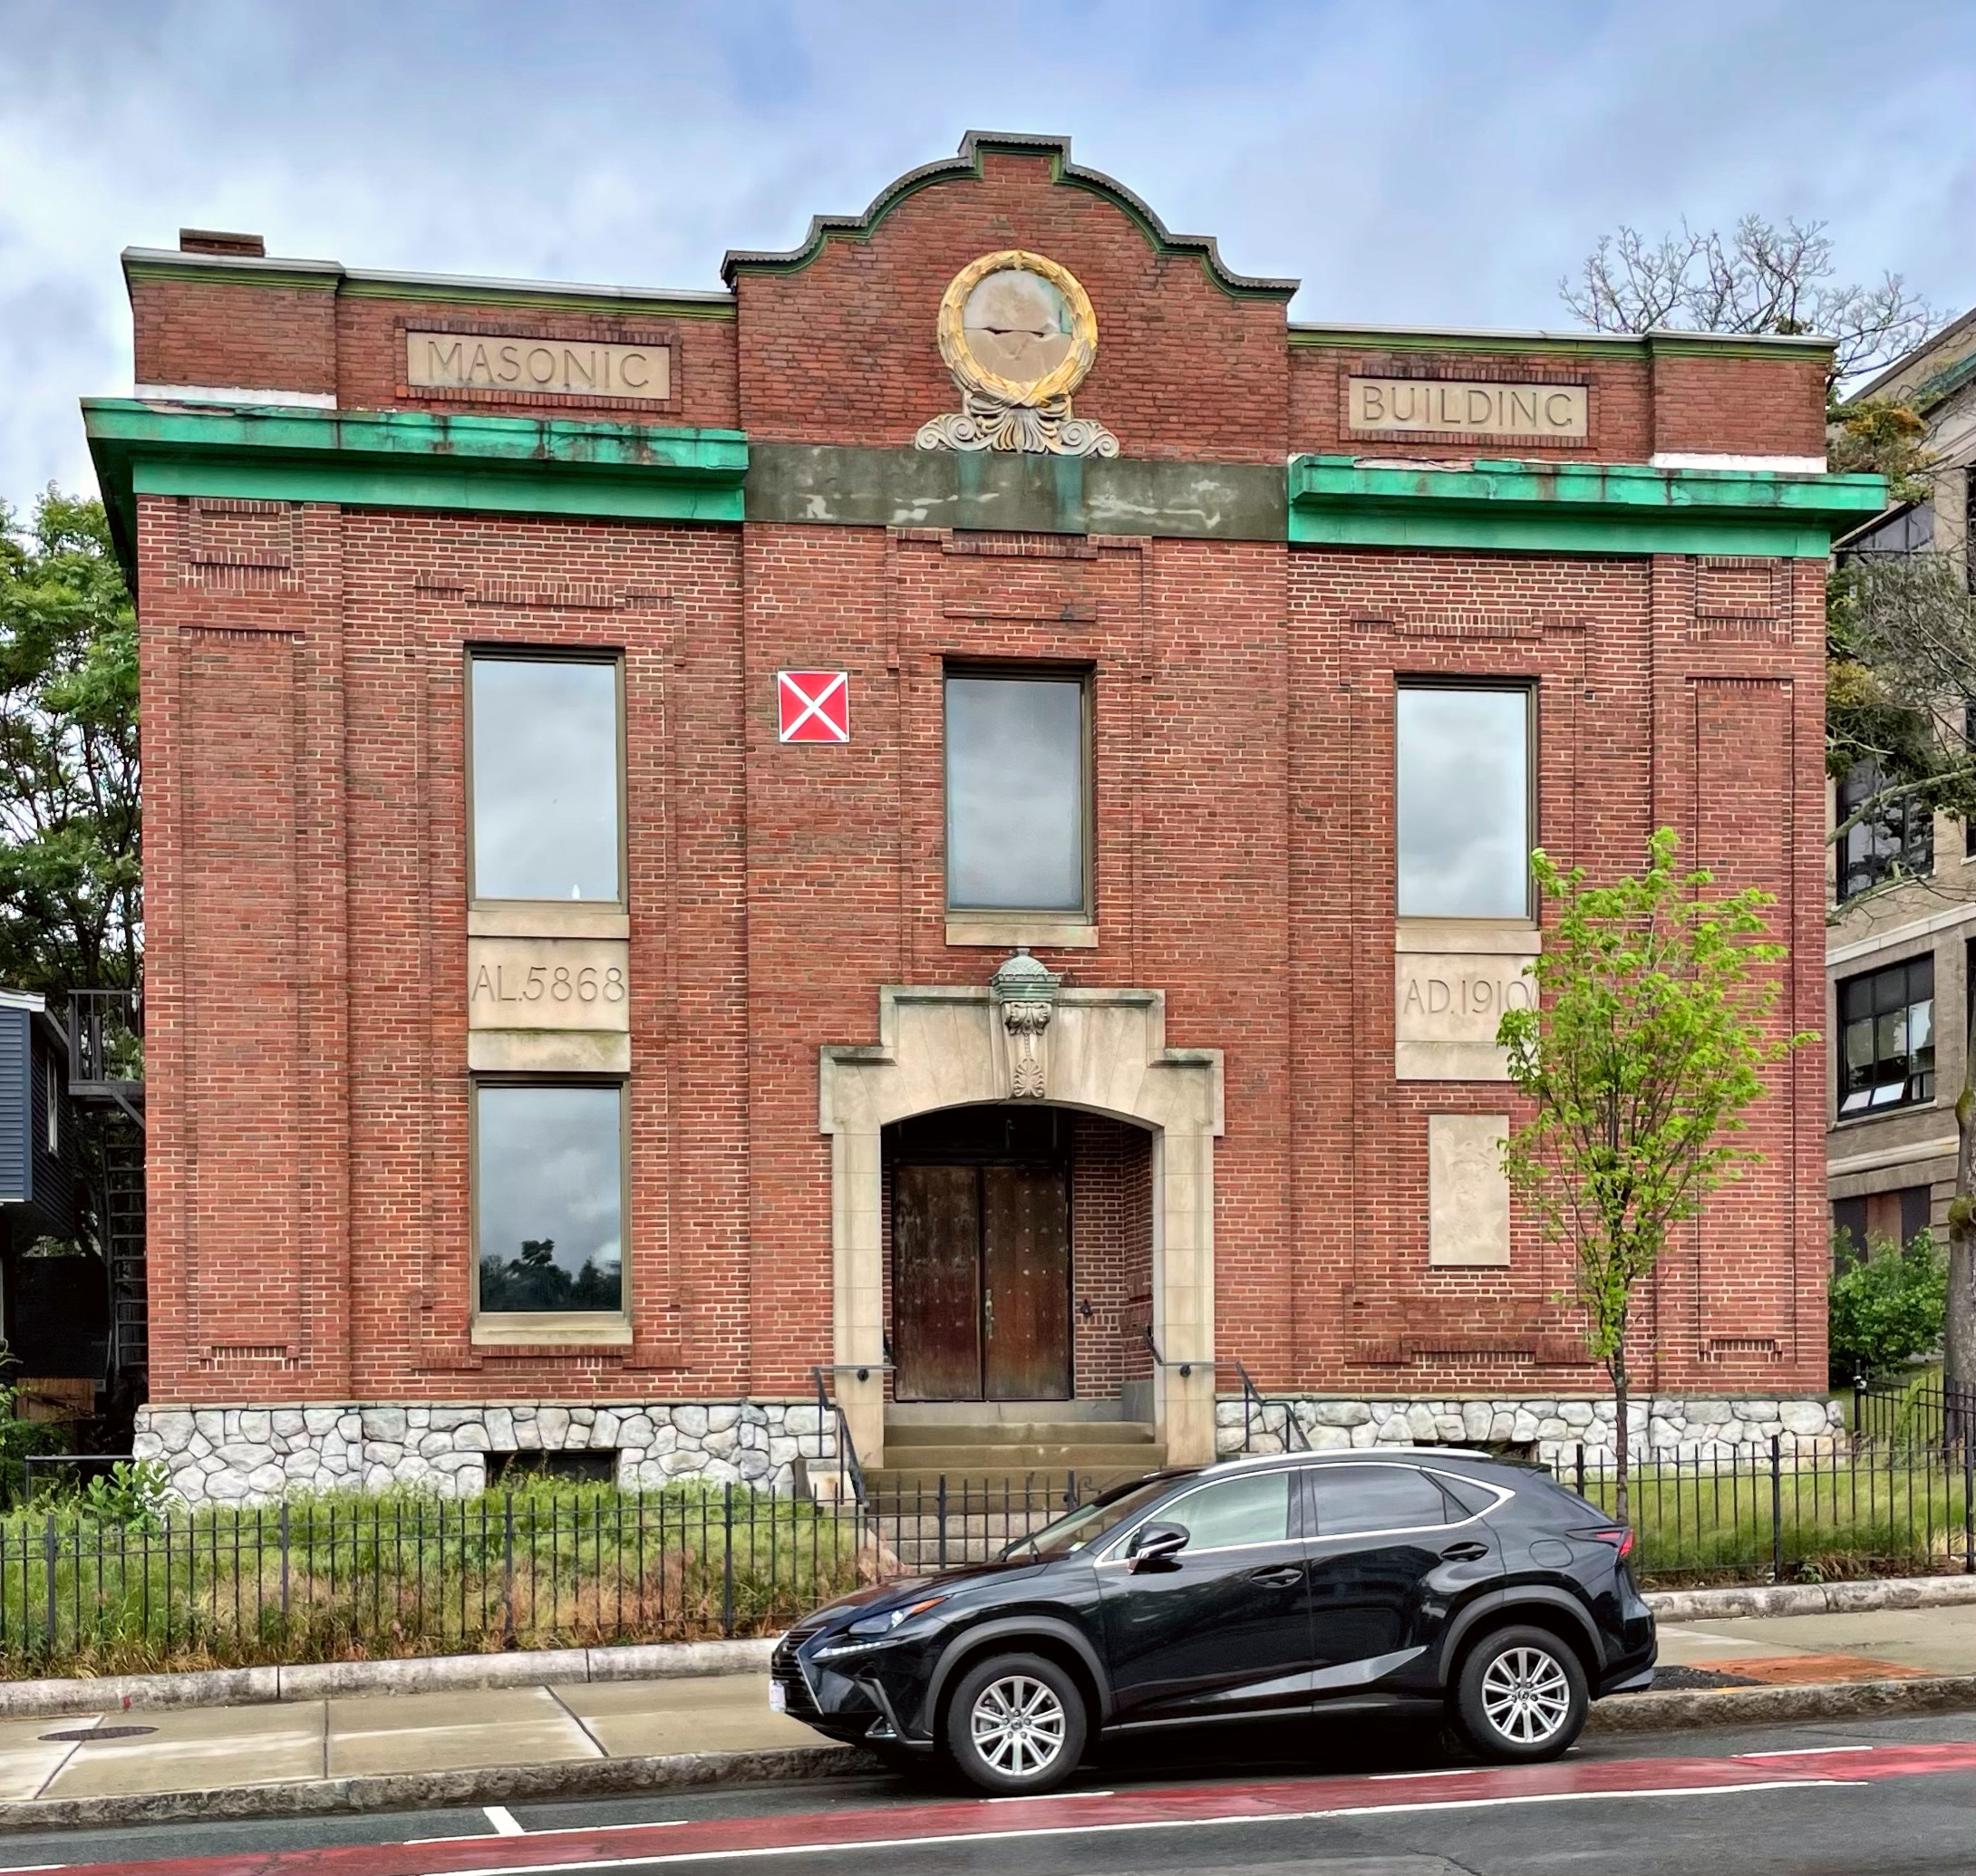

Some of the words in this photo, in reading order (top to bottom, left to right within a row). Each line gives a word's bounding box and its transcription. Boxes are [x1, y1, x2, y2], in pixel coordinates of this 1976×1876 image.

[428, 341, 649, 389] MASONIC
[1362, 385, 1573, 428] BUILDING
[470, 964, 625, 1002] AL.5868
